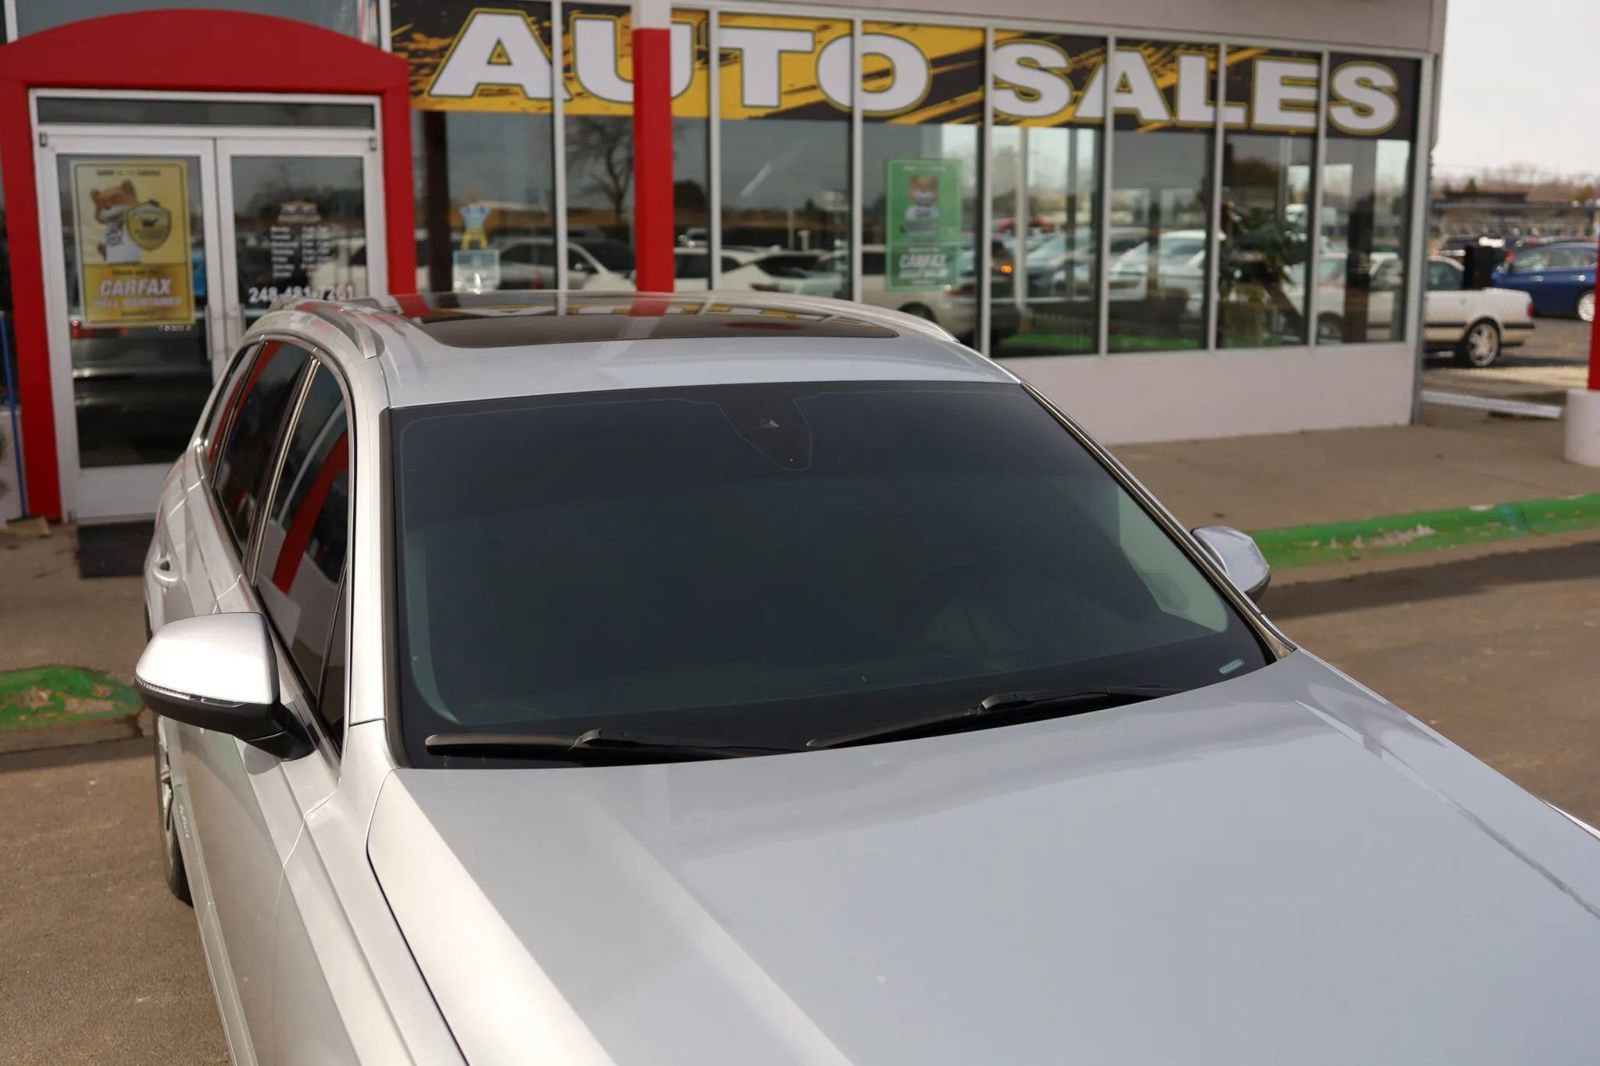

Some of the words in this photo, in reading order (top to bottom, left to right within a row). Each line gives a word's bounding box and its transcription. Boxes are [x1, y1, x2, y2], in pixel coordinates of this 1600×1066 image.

[428, 9, 932, 114] AUTO
[992, 40, 1399, 134] SALES
[100, 277, 172, 297] CARFAX
